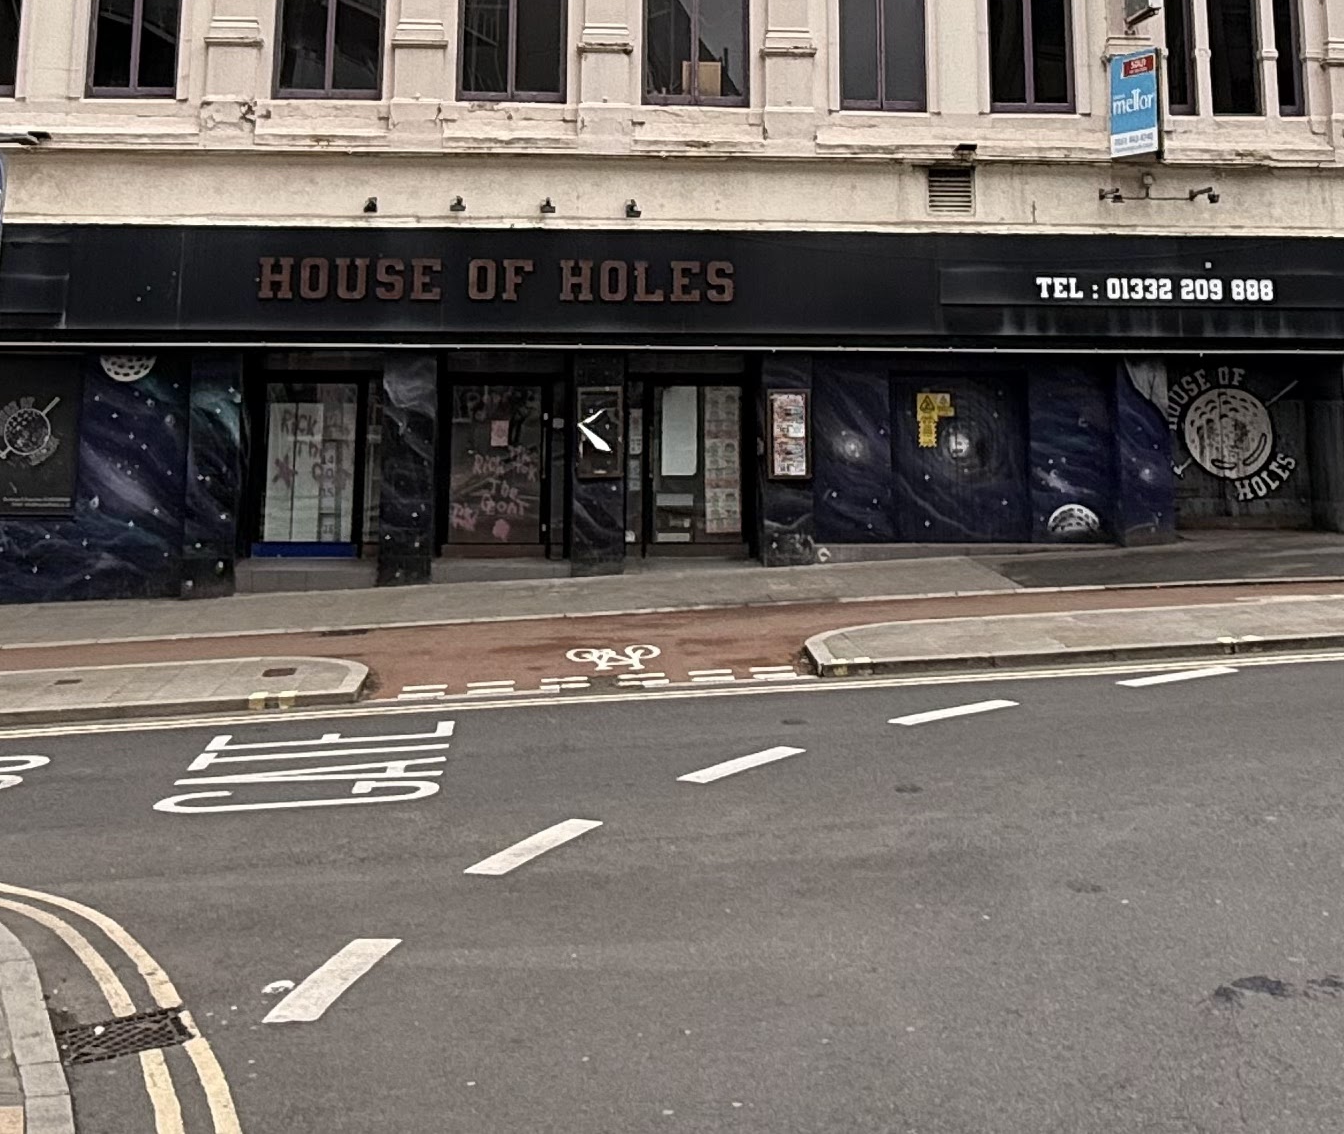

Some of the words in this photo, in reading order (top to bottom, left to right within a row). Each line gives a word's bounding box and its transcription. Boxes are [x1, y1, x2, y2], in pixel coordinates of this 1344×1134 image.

[258, 256, 443, 301] HOUSE
[467, 258, 534, 302] OF
[559, 259, 735, 303] HOLES
[1036, 277, 1083, 298] TEL
[1107, 277, 1173, 300] 01332
[1180, 278, 1223, 300] 209
[1231, 279, 1273, 301] 888
[1218, 366, 1246, 386] OF
[1234, 452, 1296, 501] HOLES
[152, 720, 456, 814] GATE
